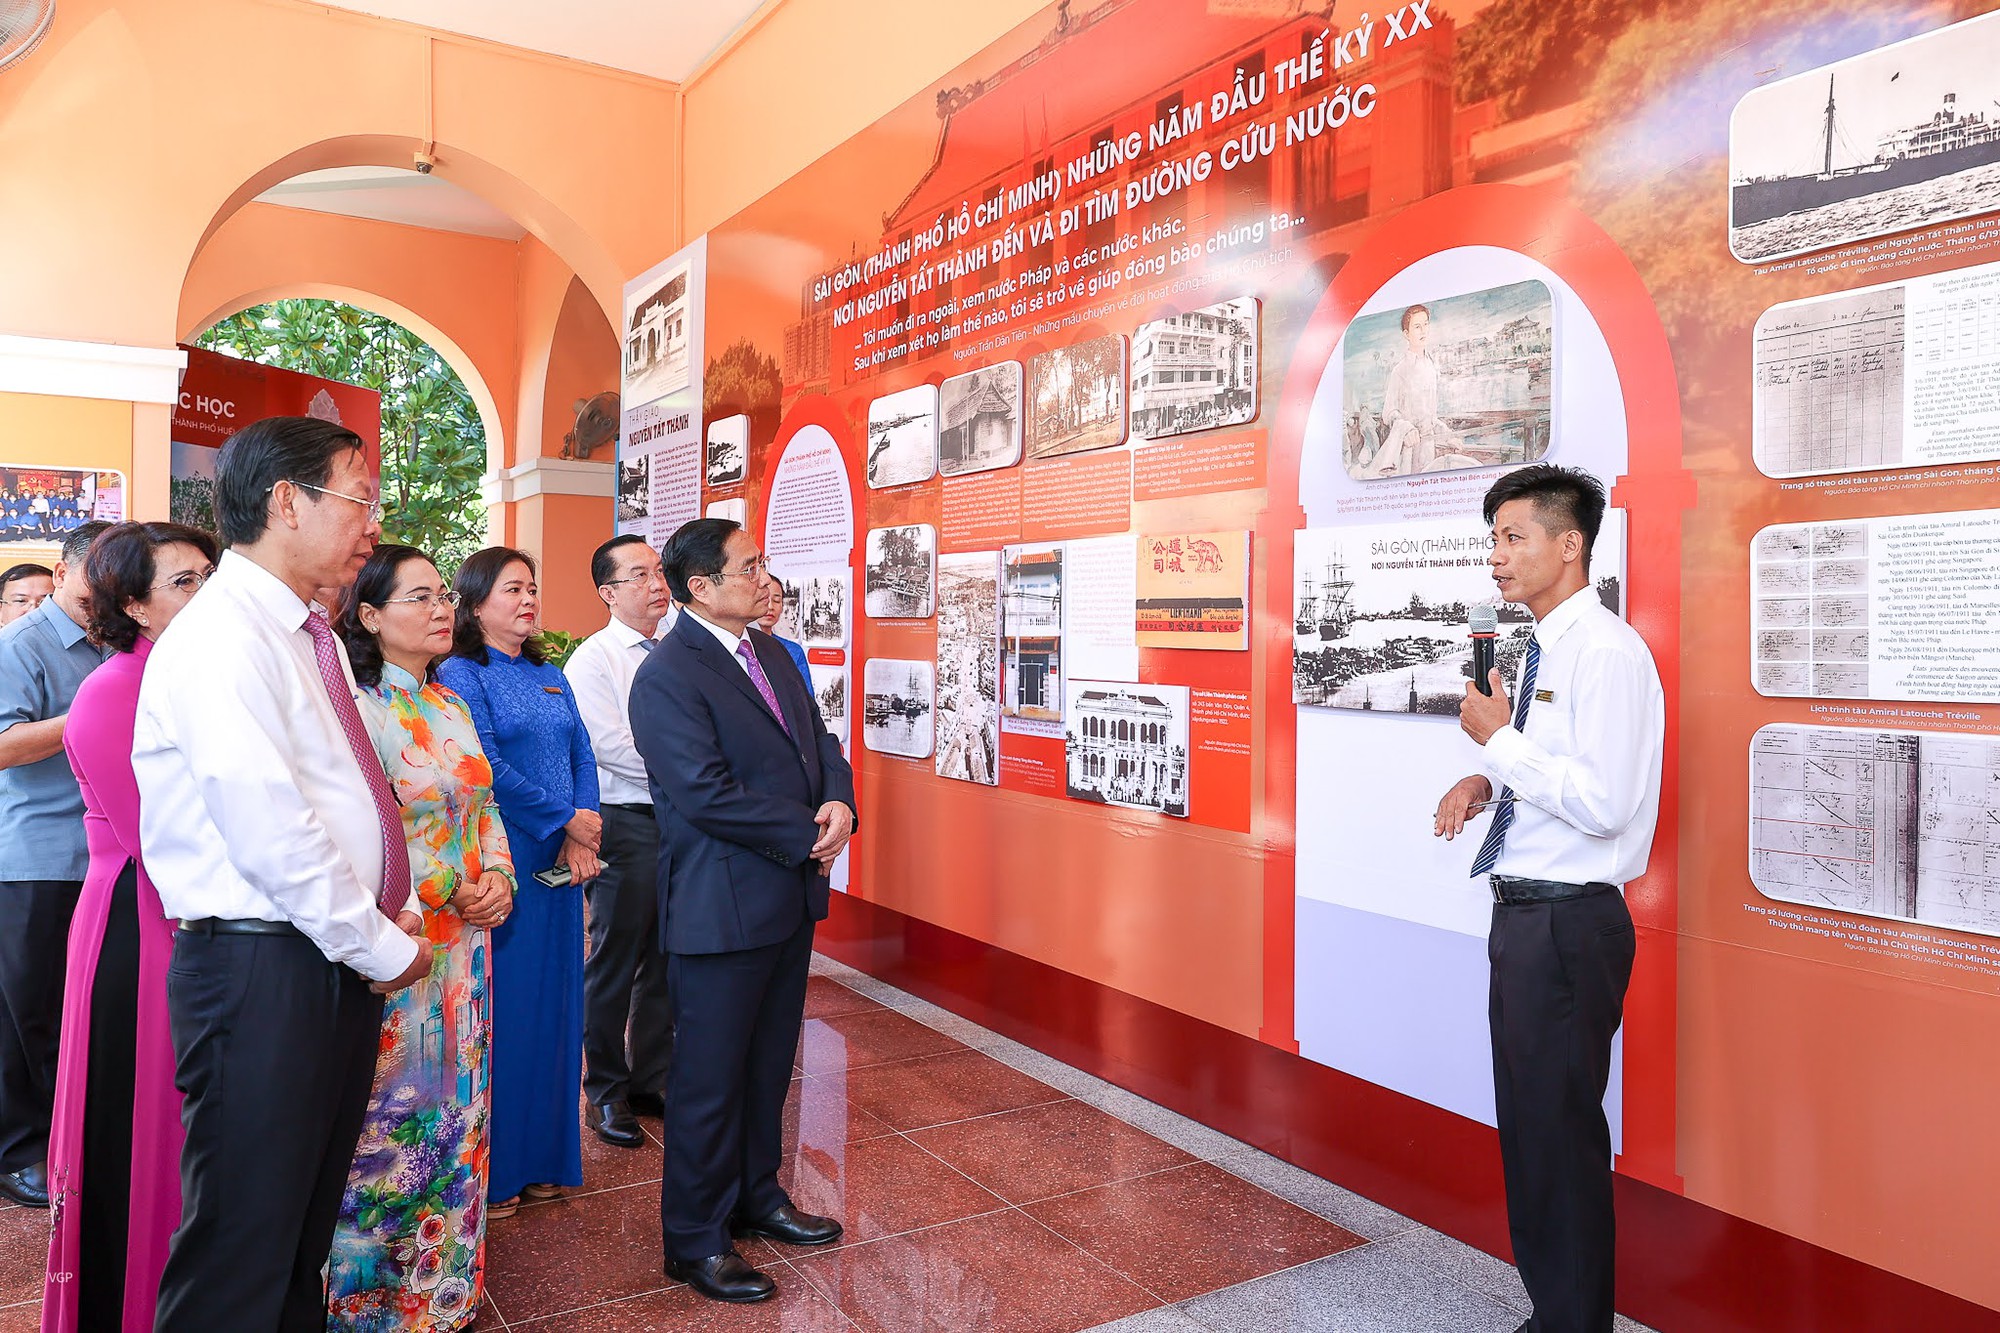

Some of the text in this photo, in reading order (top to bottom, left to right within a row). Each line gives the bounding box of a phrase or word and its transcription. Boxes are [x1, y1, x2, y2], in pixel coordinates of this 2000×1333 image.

[814, 0, 1433, 301] SÀI GÒN (THÀNH PHỐ HỒ CHÍ MINH) NHỮNG NĂM ĐẦU THẾ KỶ XX
[833, 83, 1377, 327] NƠI NGUYỄN TẤT THÀNH ĐẾN VÀ ĐI TÌM ĐƯỜNG CỨU NƯỚC
[854, 215, 1305, 371] Sau khi xem xét họ làm thế nào, tôi sẽ trở về giúp đồng bào chúng ta...
[862, 329, 875, 346] Tôi
[877, 319, 903, 341] muốn
[904, 314, 914, 331] đi
[916, 313, 926, 326] ra
[928, 299, 959, 324] ngoài,
[961, 292, 985, 310] xem
[987, 279, 1016, 301] nước
[1019, 266, 1051, 290] Pháp
[1054, 257, 1069, 278] và
[1072, 250, 1097, 271] các
[1101, 235, 1138, 261] nước
[1142, 220, 1186, 247] khác.
[196, 394, 235, 419] HỌC
[629, 413, 689, 447] NGUYỄN TẤT THÀNH
[1371, 539, 1387, 554] SÀI
[1390, 538, 1418, 554] GÒN
[1421, 535, 1464, 554] (THÀNH
[1810, 704, 1829, 714] Lịch
[1851, 706, 1867, 715] tàu
[1868, 708, 1898, 716] Amiral
[1900, 709, 1944, 718] Latouche
[1945, 709, 1980, 719] Tréville
